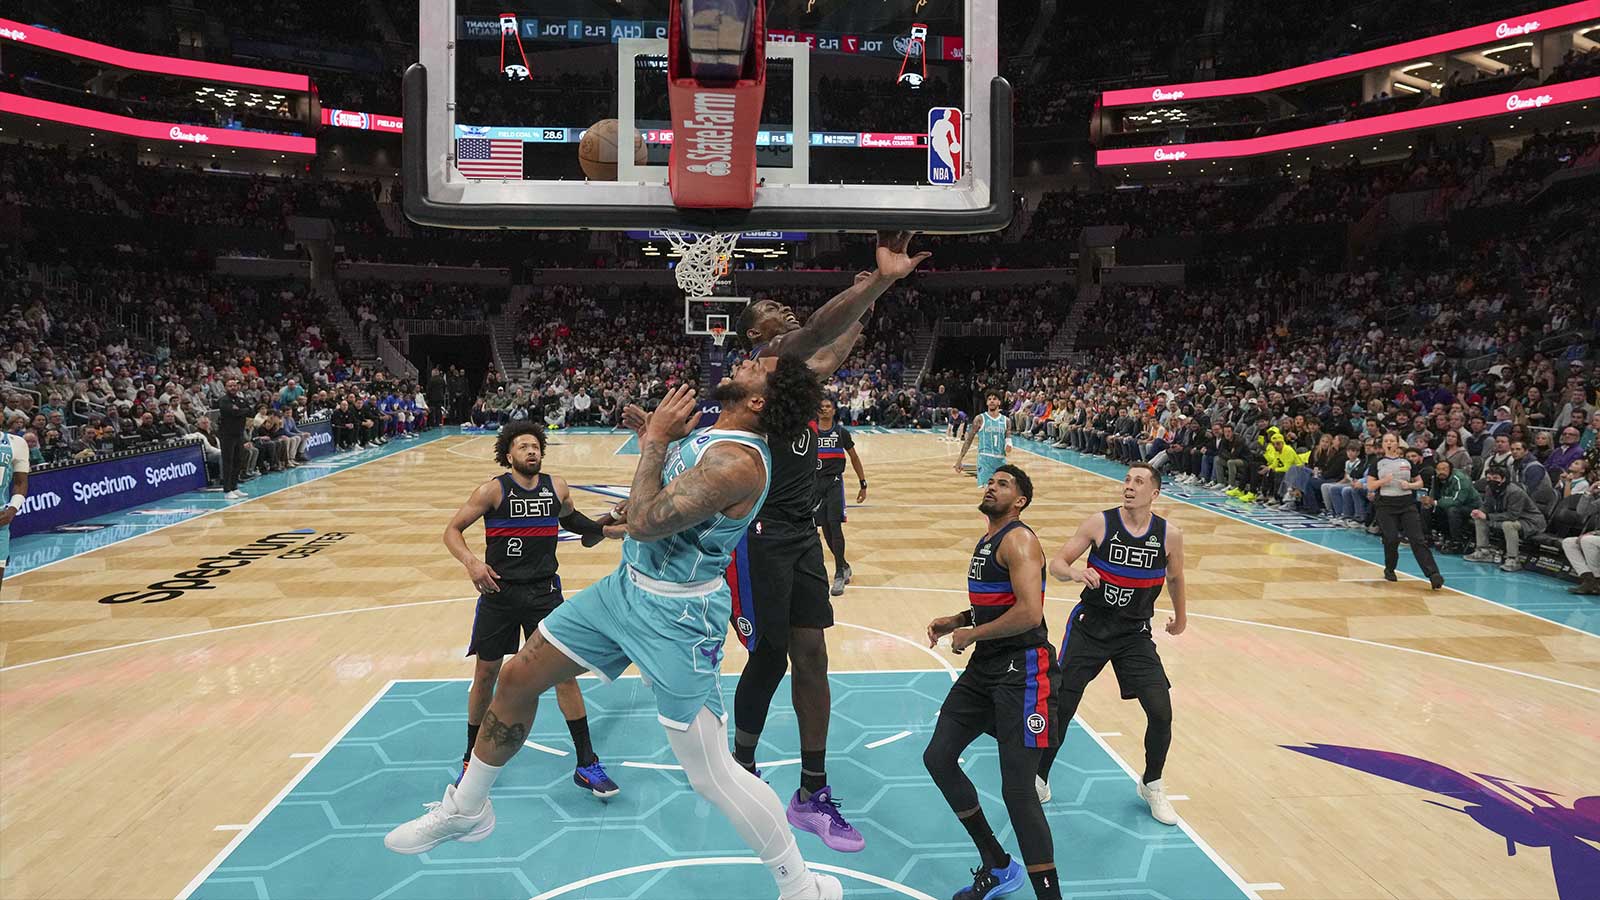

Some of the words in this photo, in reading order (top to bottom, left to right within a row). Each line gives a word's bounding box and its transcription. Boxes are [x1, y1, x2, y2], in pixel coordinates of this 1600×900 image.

[543, 131, 563, 140] 28.6
[933, 167, 949, 180] NBA
[993, 434, 999, 447] 1
[145, 461, 192, 488] Spectrum
[72, 475, 131, 505] Spectrum
[510, 498, 553, 518] DET
[276, 531, 355, 560] CENTER
[506, 537, 523, 556] 2
[1108, 543, 1159, 569] DET
[98, 531, 316, 605] Spectrum
[1104, 583, 1135, 607] 55
